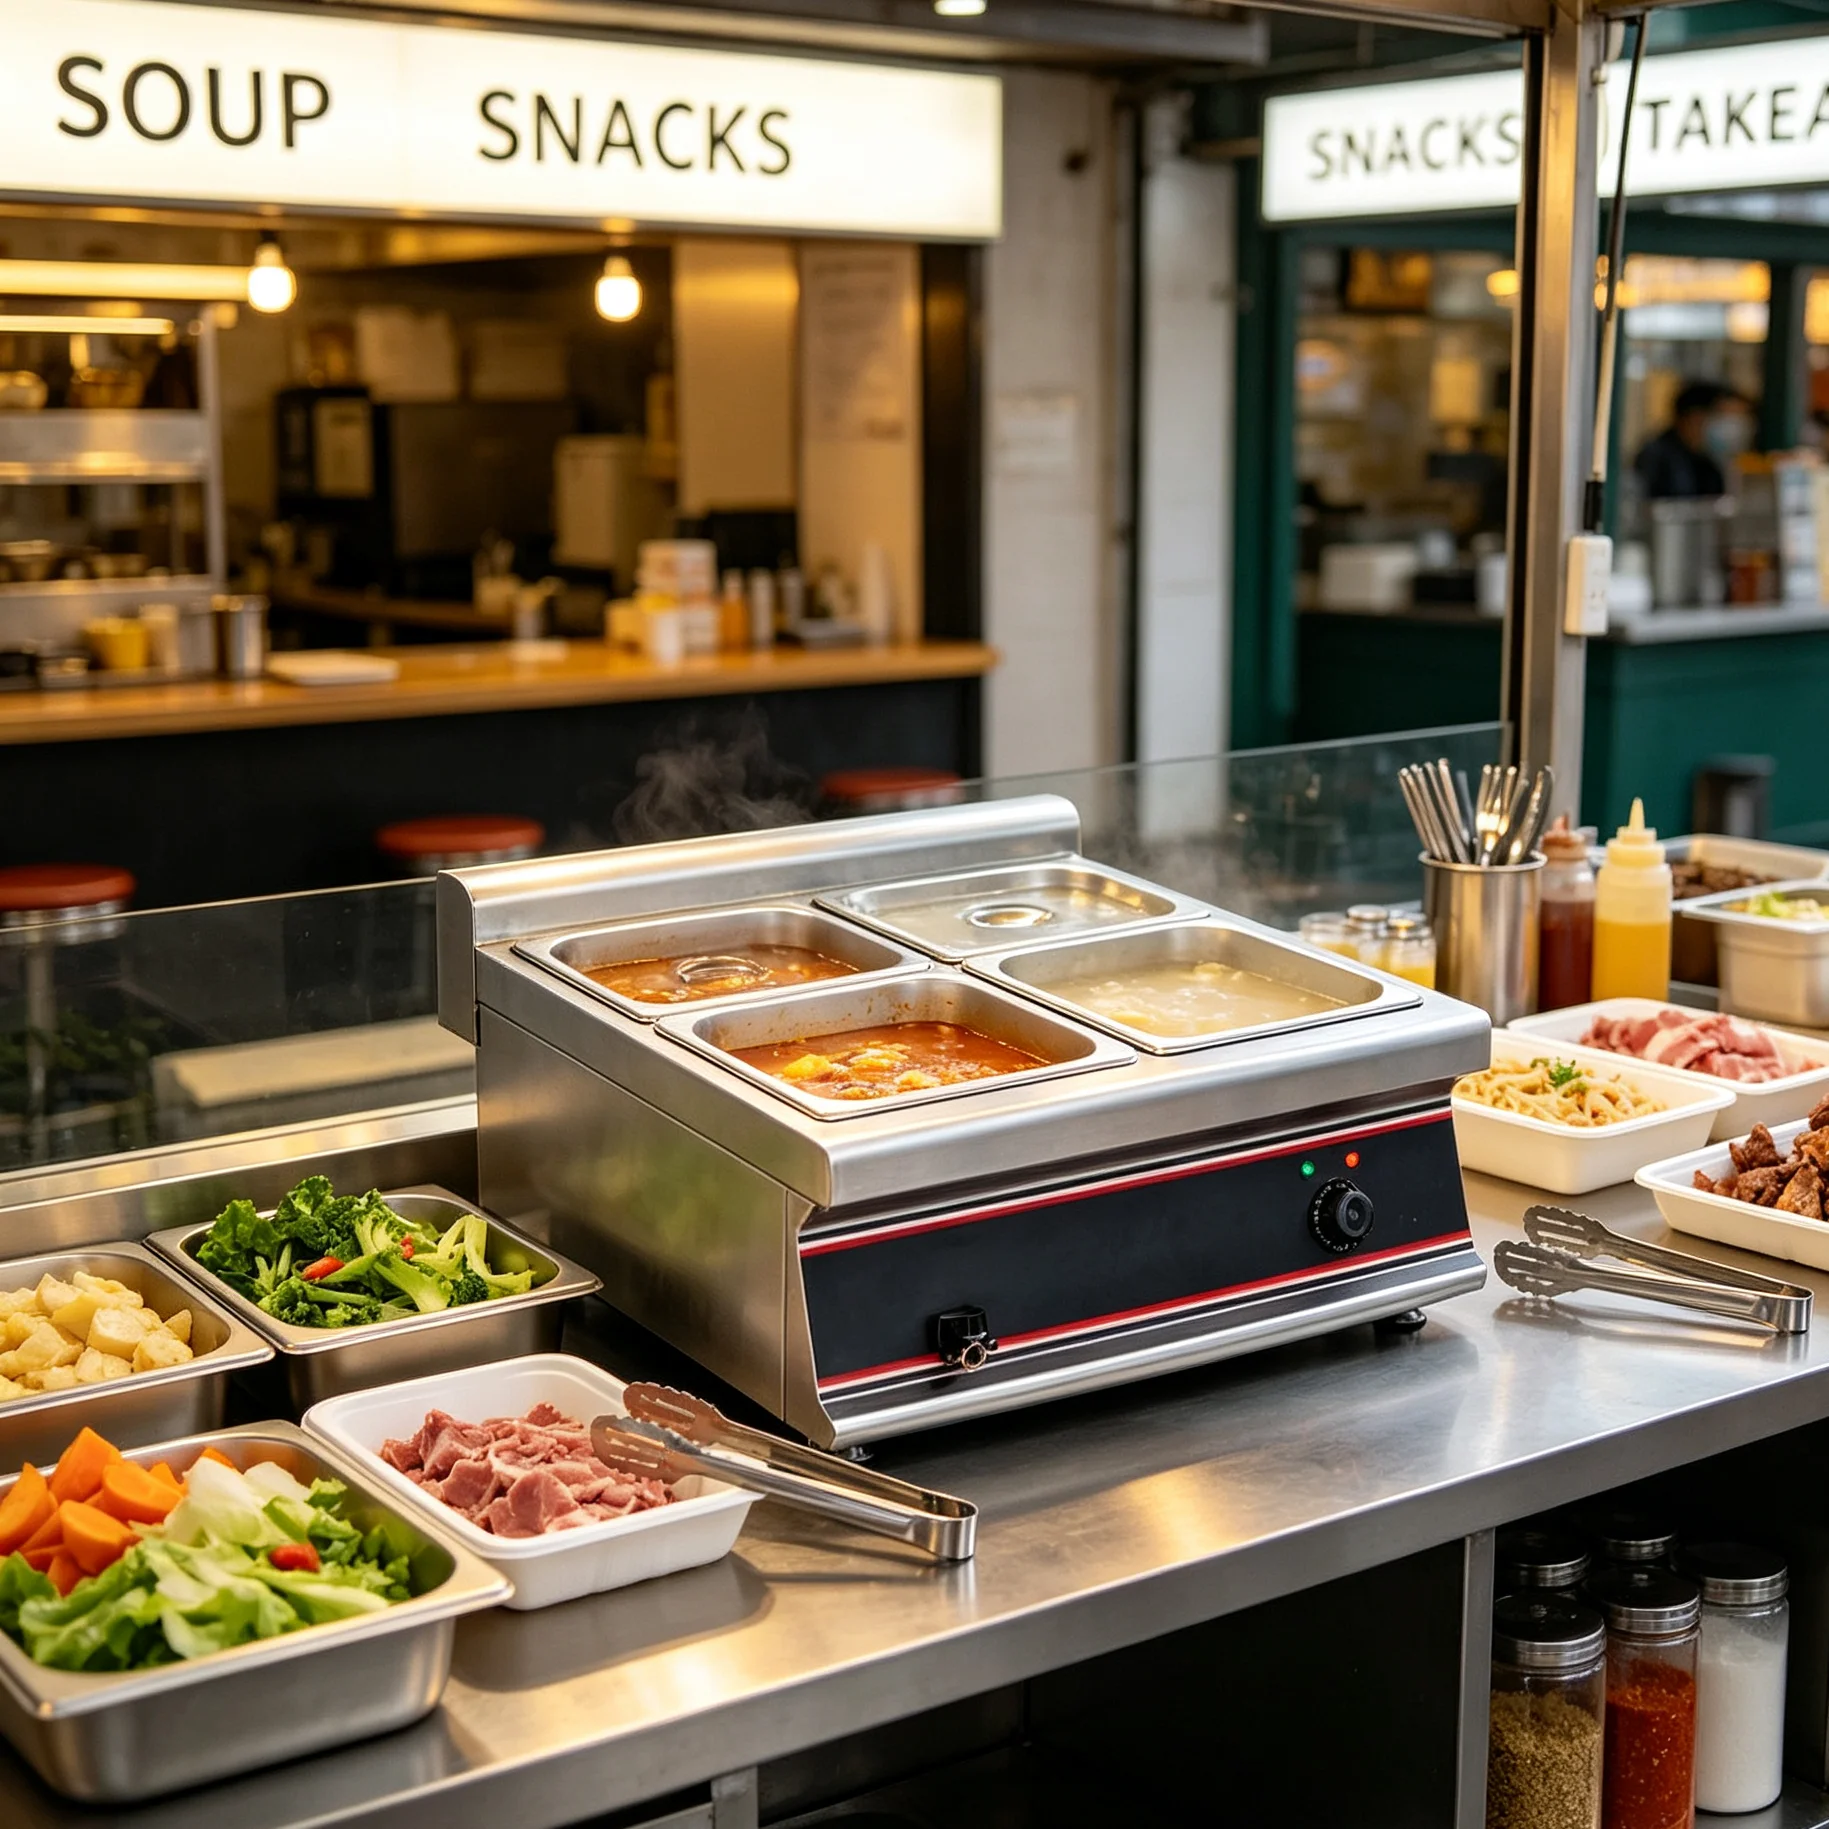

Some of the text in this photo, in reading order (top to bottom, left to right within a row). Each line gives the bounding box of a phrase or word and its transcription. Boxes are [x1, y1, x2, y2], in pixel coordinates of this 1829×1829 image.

[57, 56, 791, 176] SOUP SNACKS
[1309, 112, 1520, 181] SNACKS
